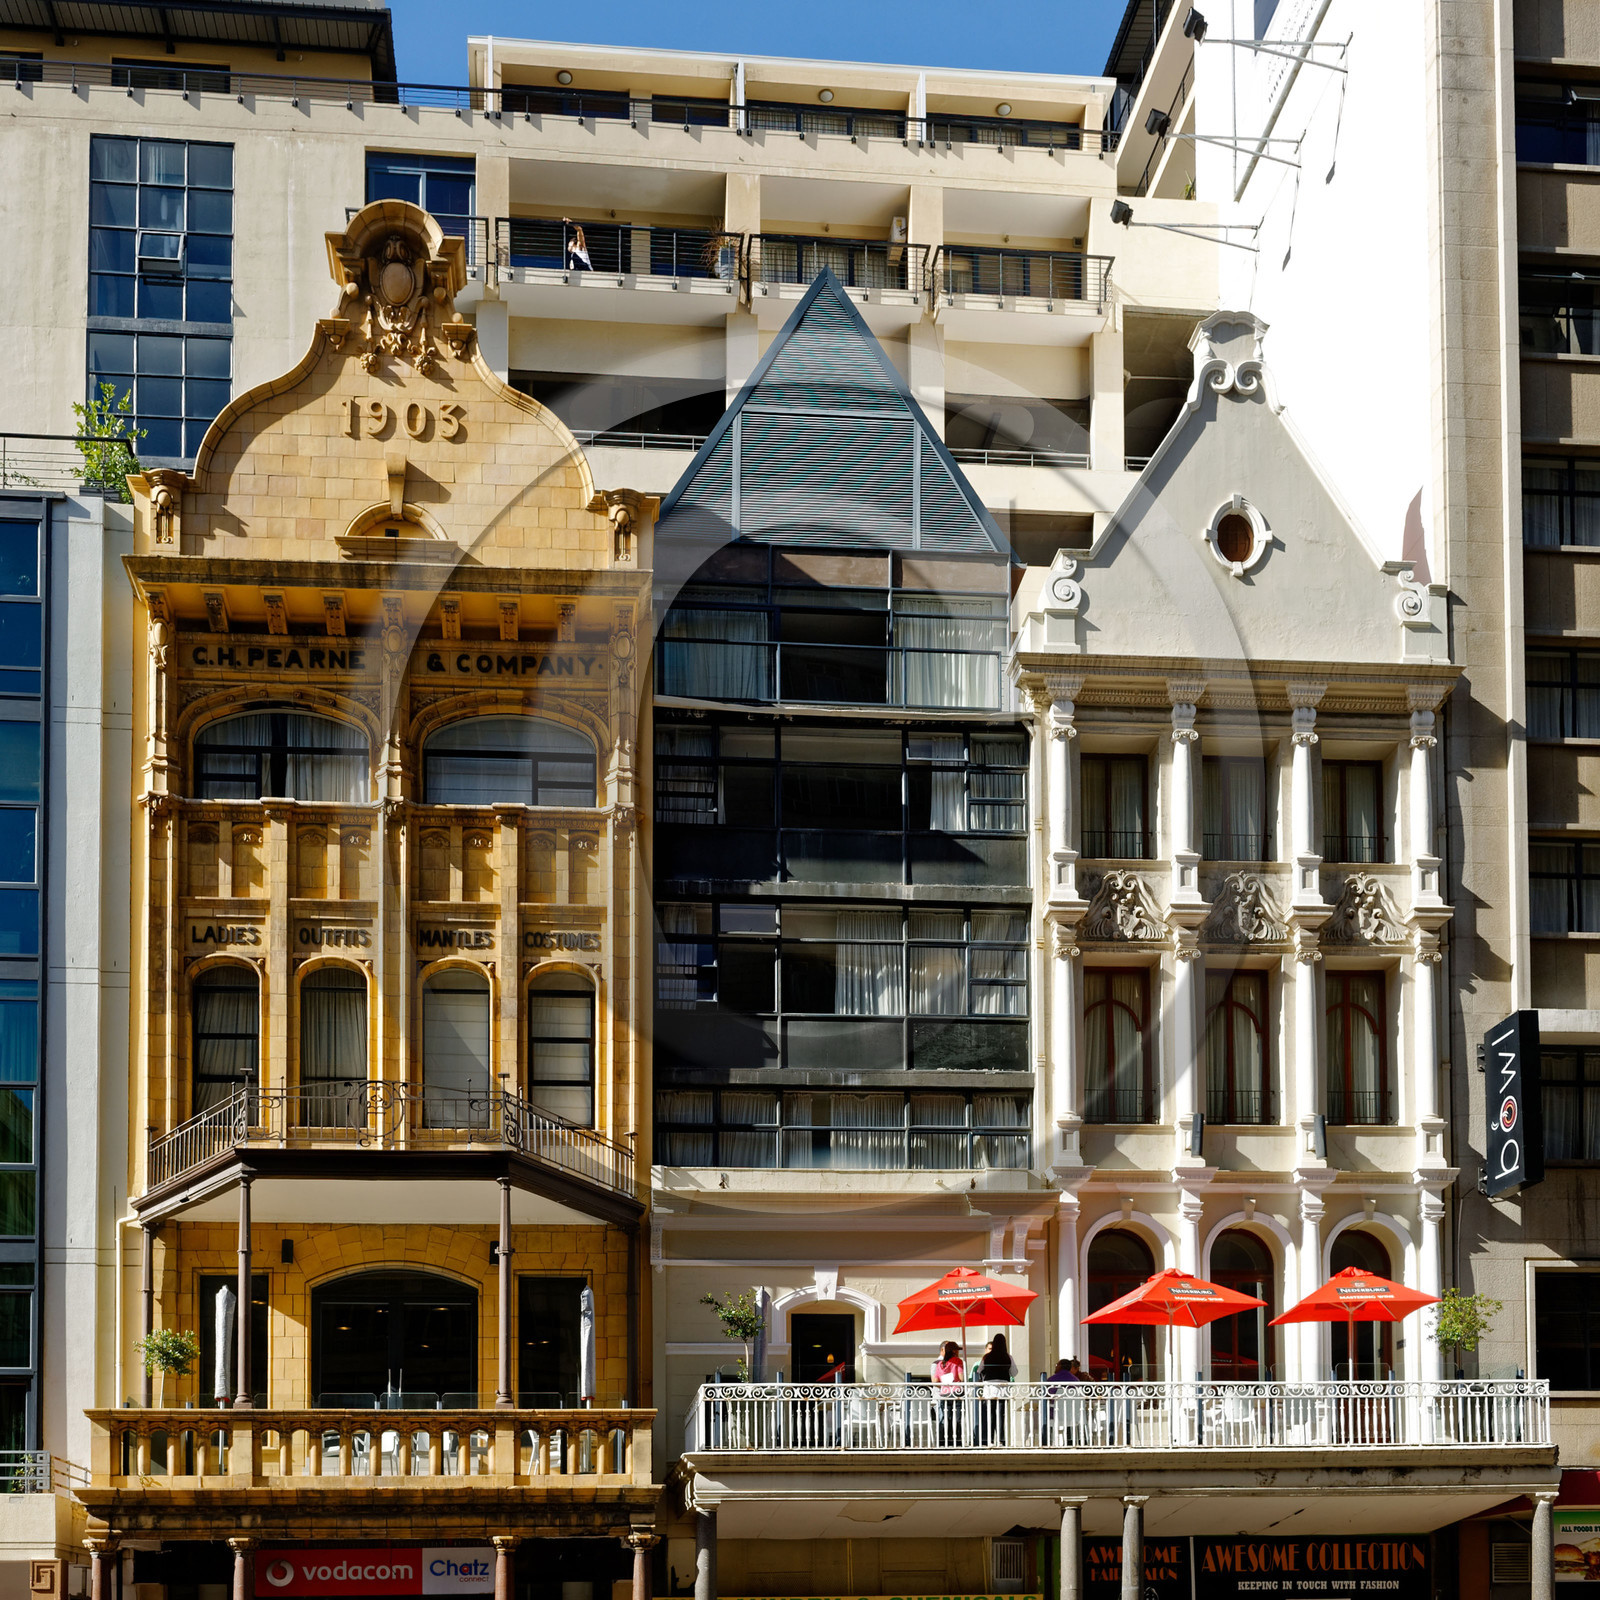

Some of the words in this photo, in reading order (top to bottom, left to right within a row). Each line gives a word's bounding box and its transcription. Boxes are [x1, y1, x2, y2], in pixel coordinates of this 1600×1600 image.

[341, 398, 459, 438] 1903
[247, 648, 366, 669] PEARNE
[426, 653, 446, 672] &
[191, 926, 258, 943] LADIES
[299, 927, 371, 946] OUTFITS
[418, 930, 493, 947] MANTLES
[524, 931, 601, 949] COSTUMES
[429, 1559, 490, 1577] Chatz
[1202, 1543, 1300, 1573] AWESOME
[1306, 1542, 1427, 1571] COLLECTION
[302, 1560, 414, 1581] vodacom
[1237, 1580, 1279, 1591] KEEPING
[1282, 1580, 1293, 1590] IN
[1296, 1580, 1328, 1590] TOUCH
[1331, 1580, 1357, 1590] WITH
[1360, 1580, 1400, 1590] FASHION
